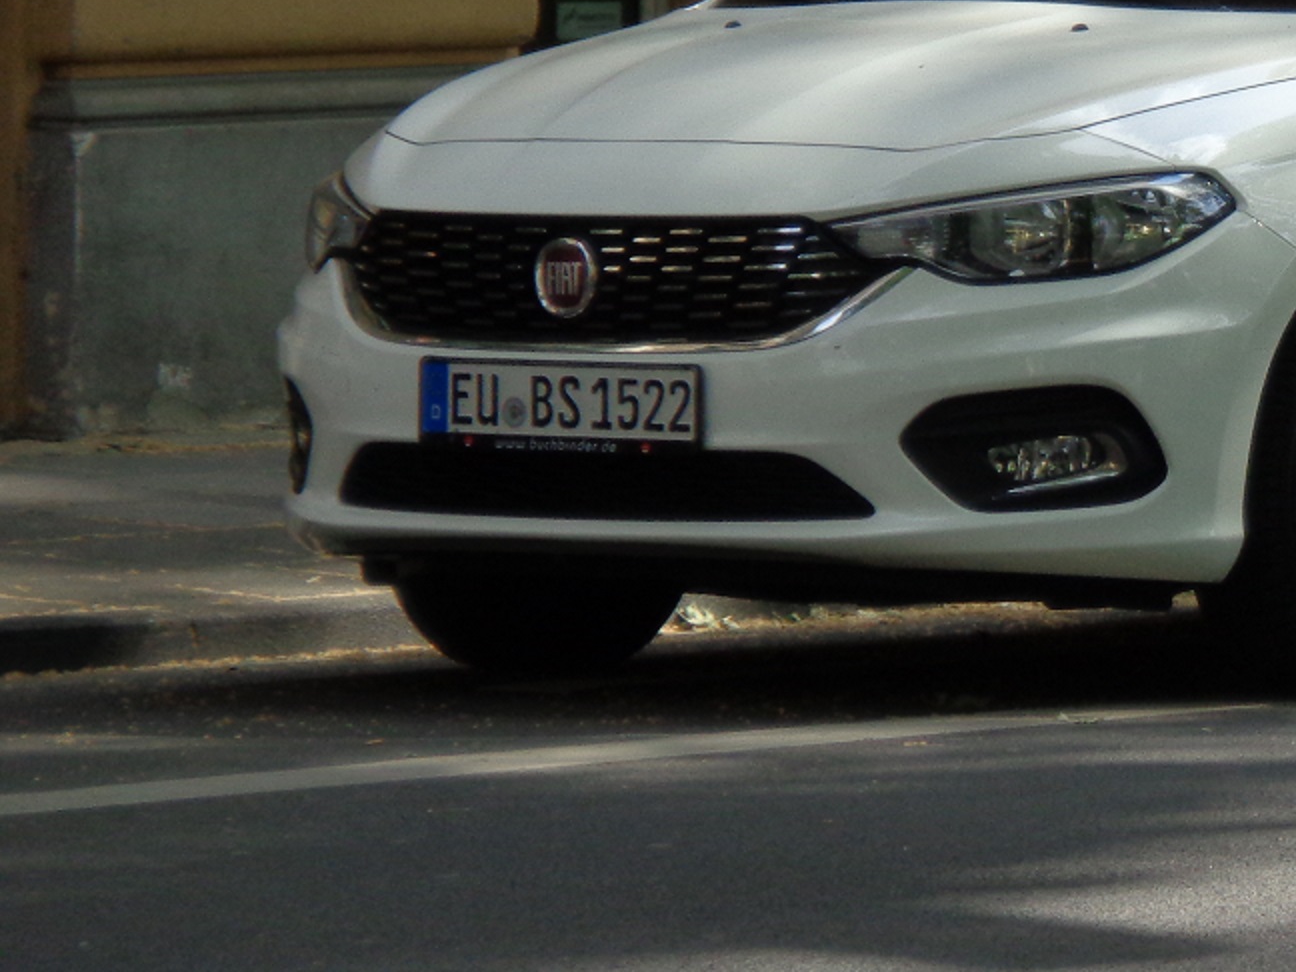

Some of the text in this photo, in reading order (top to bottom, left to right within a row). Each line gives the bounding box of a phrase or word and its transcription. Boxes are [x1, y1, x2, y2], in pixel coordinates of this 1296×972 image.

[547, 261, 582, 295] FIAT
[451, 372, 691, 432] EU BS 1522
